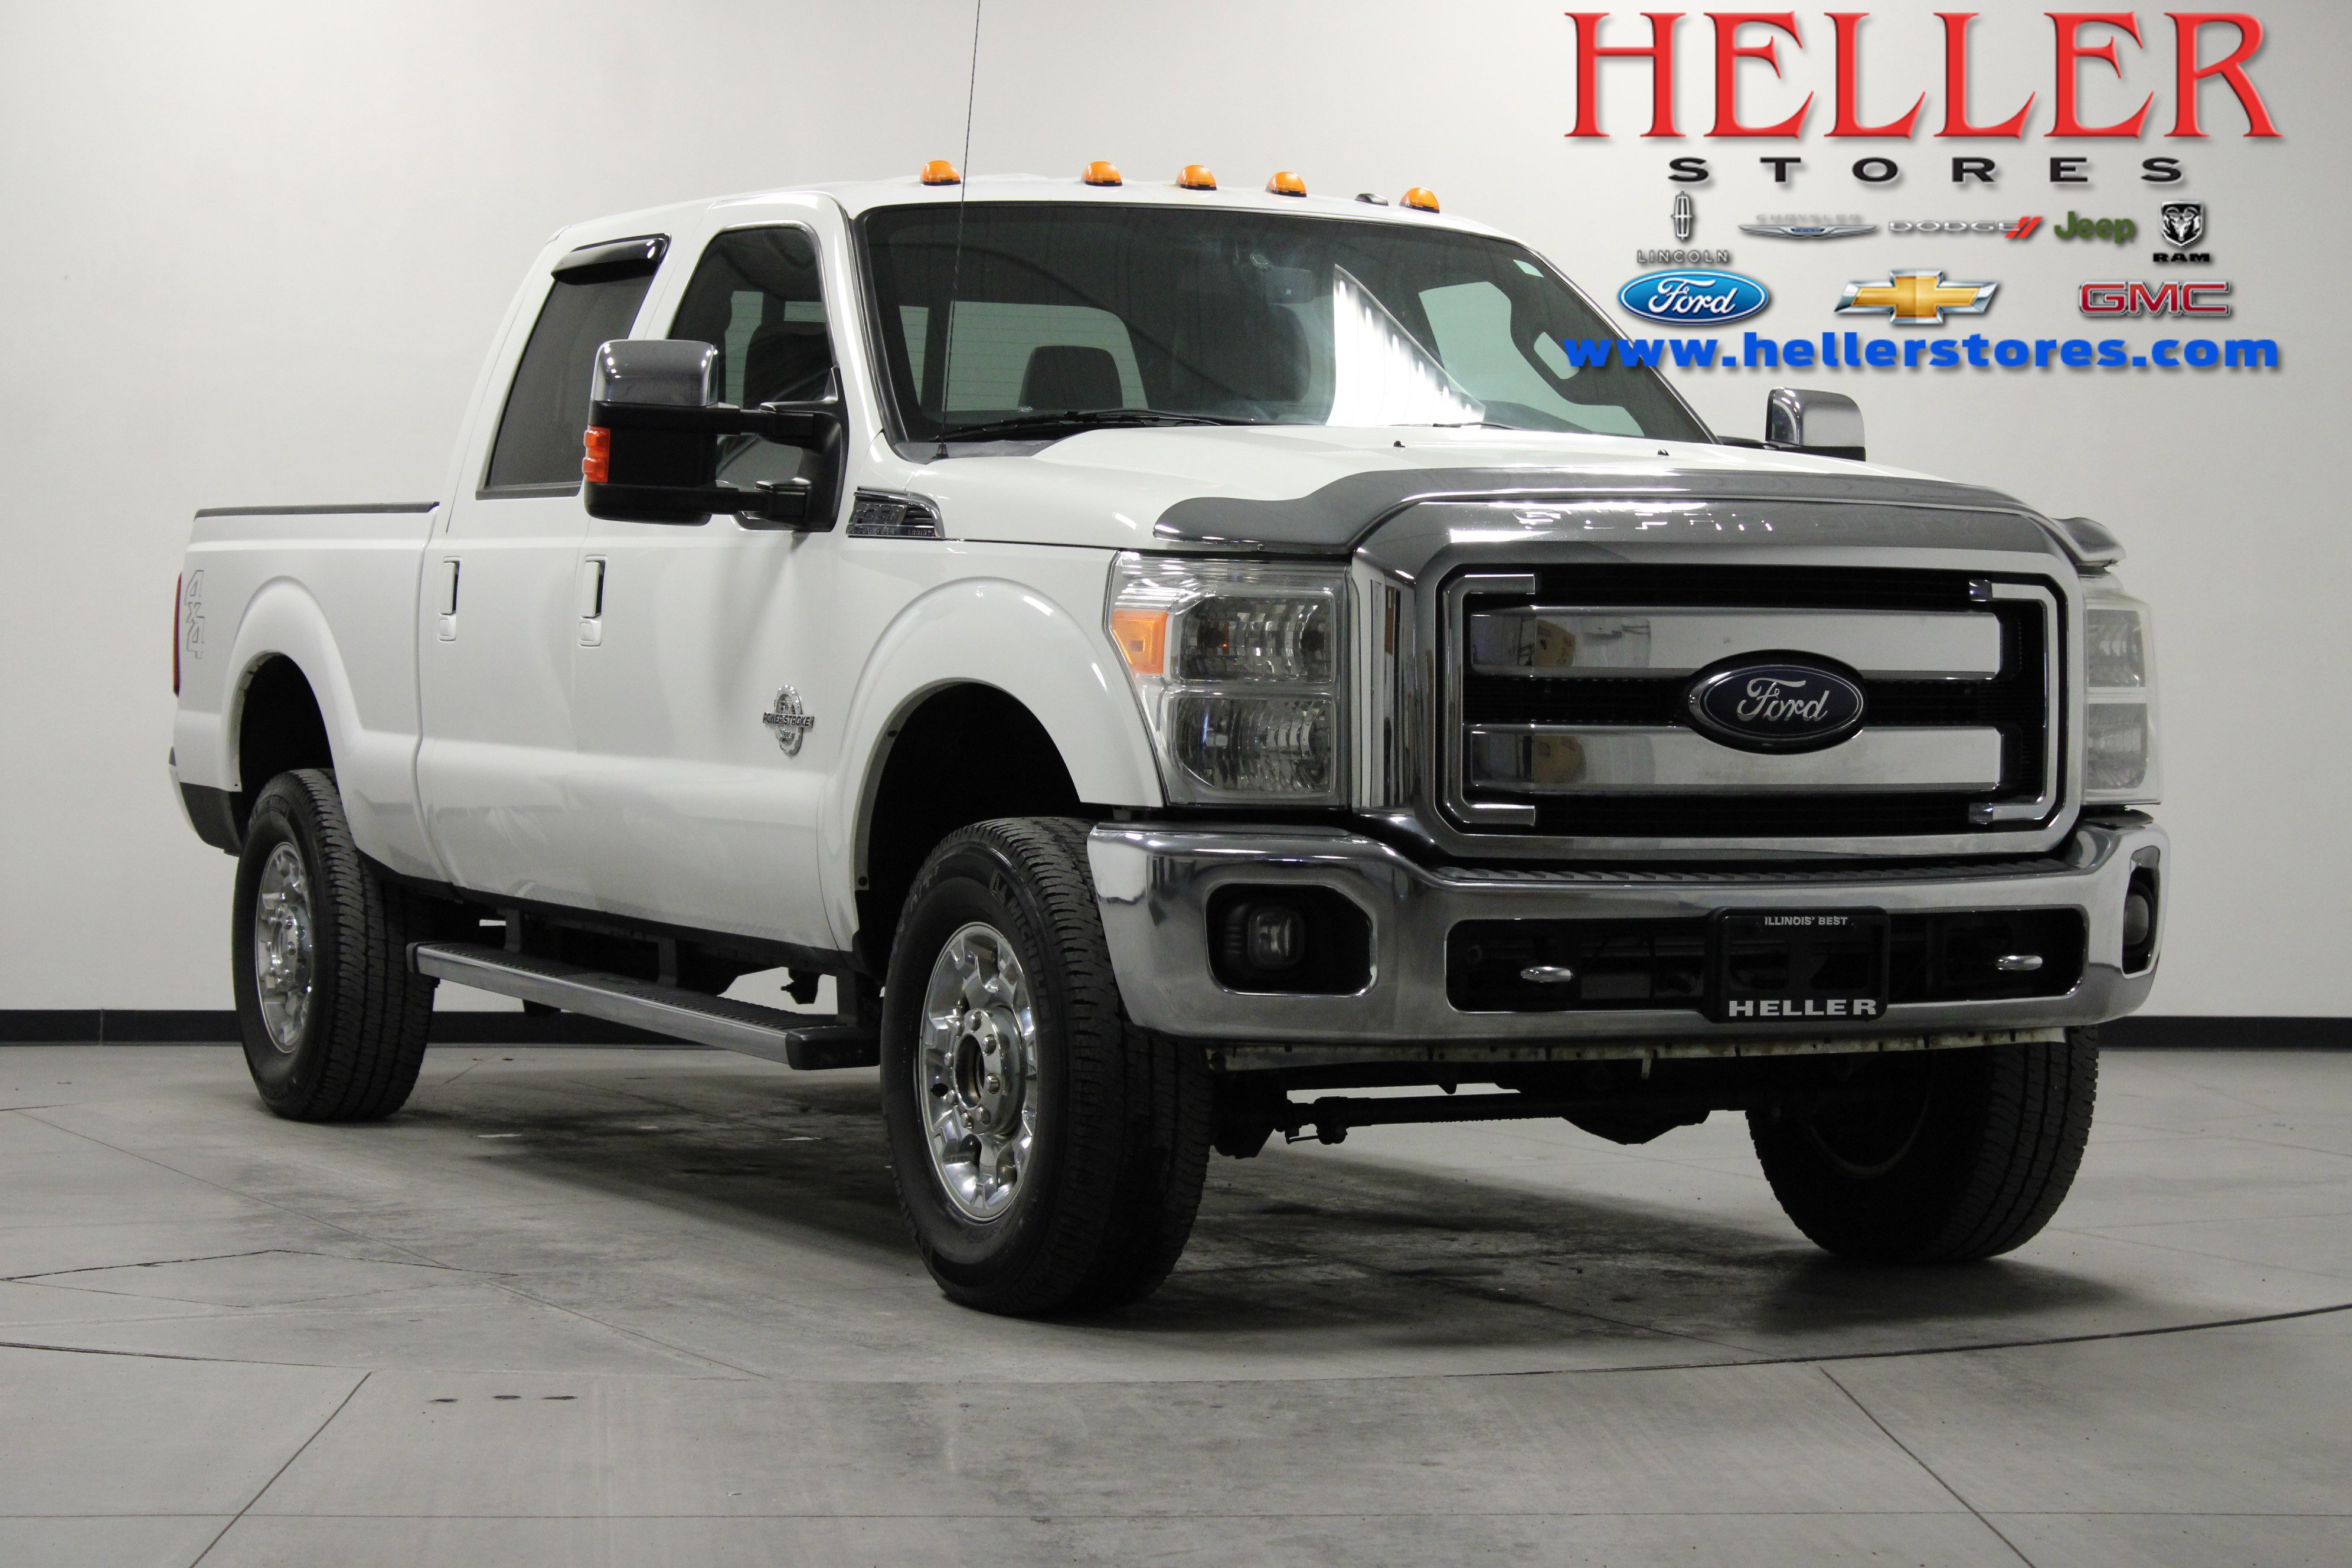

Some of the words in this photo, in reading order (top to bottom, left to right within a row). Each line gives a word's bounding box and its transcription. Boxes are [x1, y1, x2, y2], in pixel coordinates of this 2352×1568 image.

[1736, 677, 1830, 722] Ford
[1818, 916, 1848, 926] BEST
[1729, 999, 1877, 1017] HELLER
